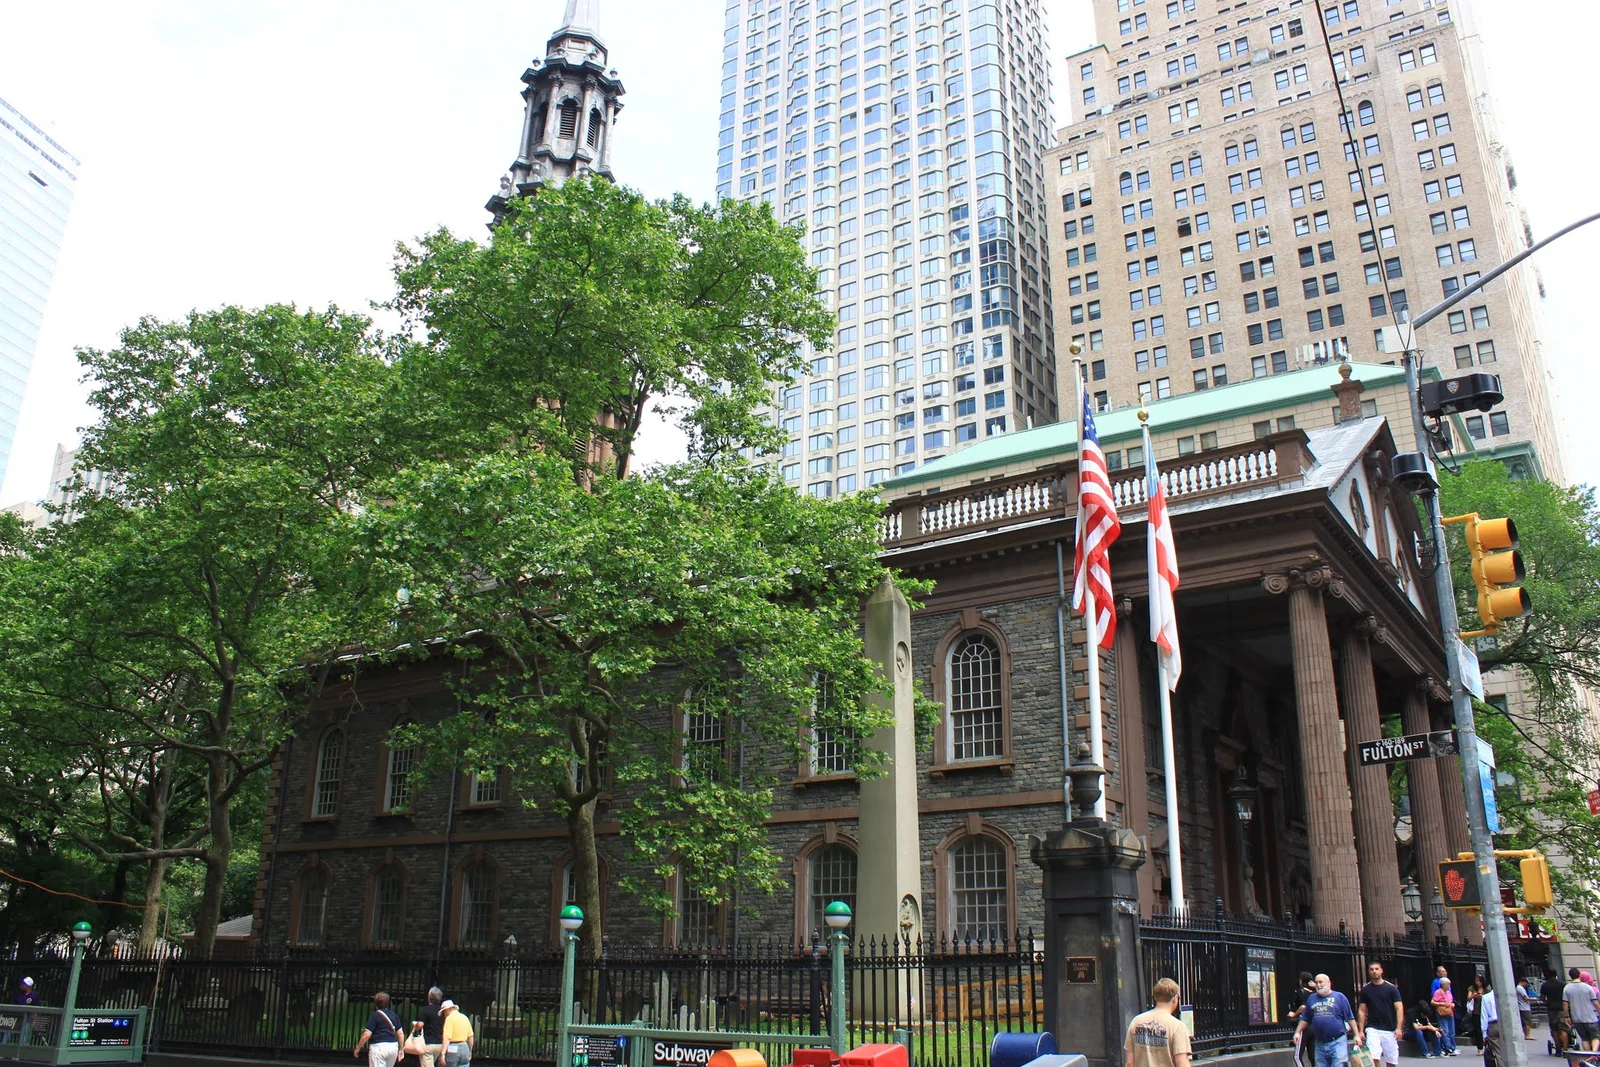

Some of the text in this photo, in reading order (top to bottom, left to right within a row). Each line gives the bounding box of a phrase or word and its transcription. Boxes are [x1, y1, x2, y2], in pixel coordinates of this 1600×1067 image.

[1362, 741, 1424, 762] FULTON ST
[654, 1042, 715, 1067] Subway
